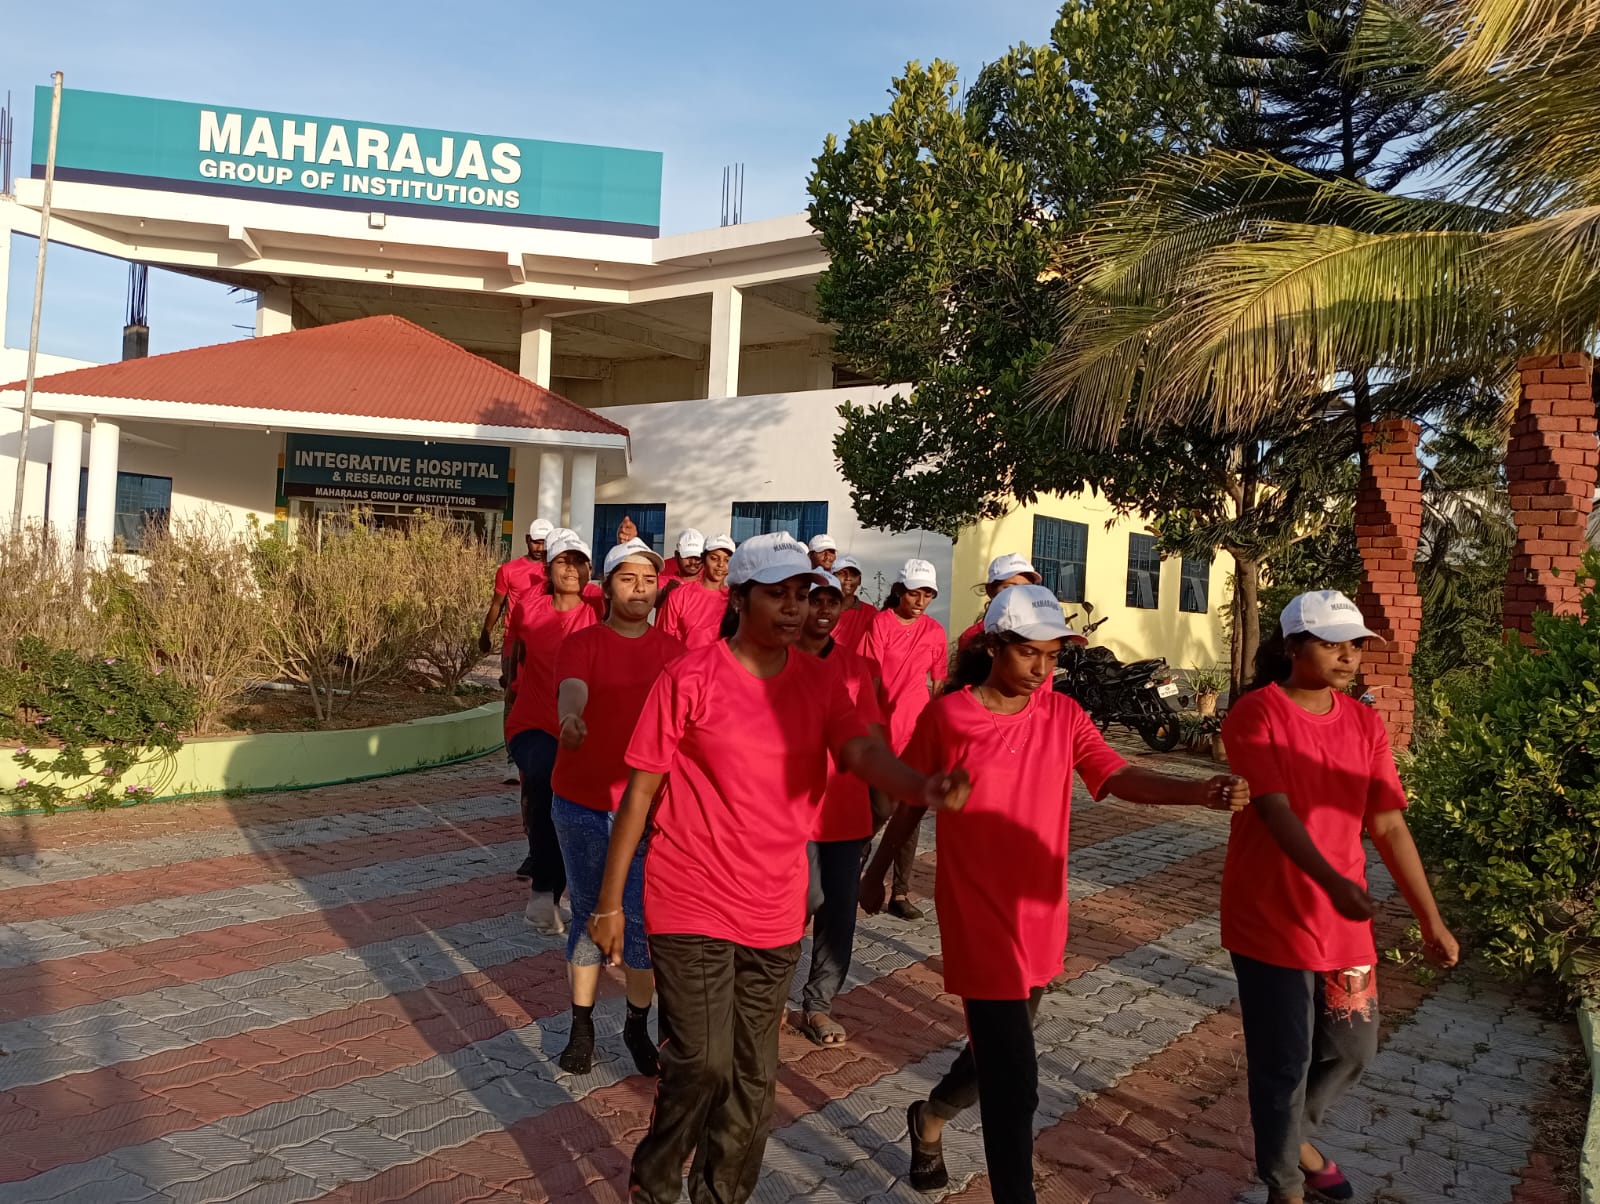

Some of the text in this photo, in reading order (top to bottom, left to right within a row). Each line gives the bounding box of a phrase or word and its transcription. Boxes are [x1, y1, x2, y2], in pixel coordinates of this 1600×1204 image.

[199, 110, 522, 184] MAHARAJAS
[199, 158, 520, 208] GROUP OF INSTITUTIONS
[295, 450, 499, 479] INTEGRATIVE HOSPITAL
[332, 471, 462, 490] & RESEARCH CENTRE
[315, 487, 477, 506] MAHARAJAS GROUP OF INSTITUTIONS
